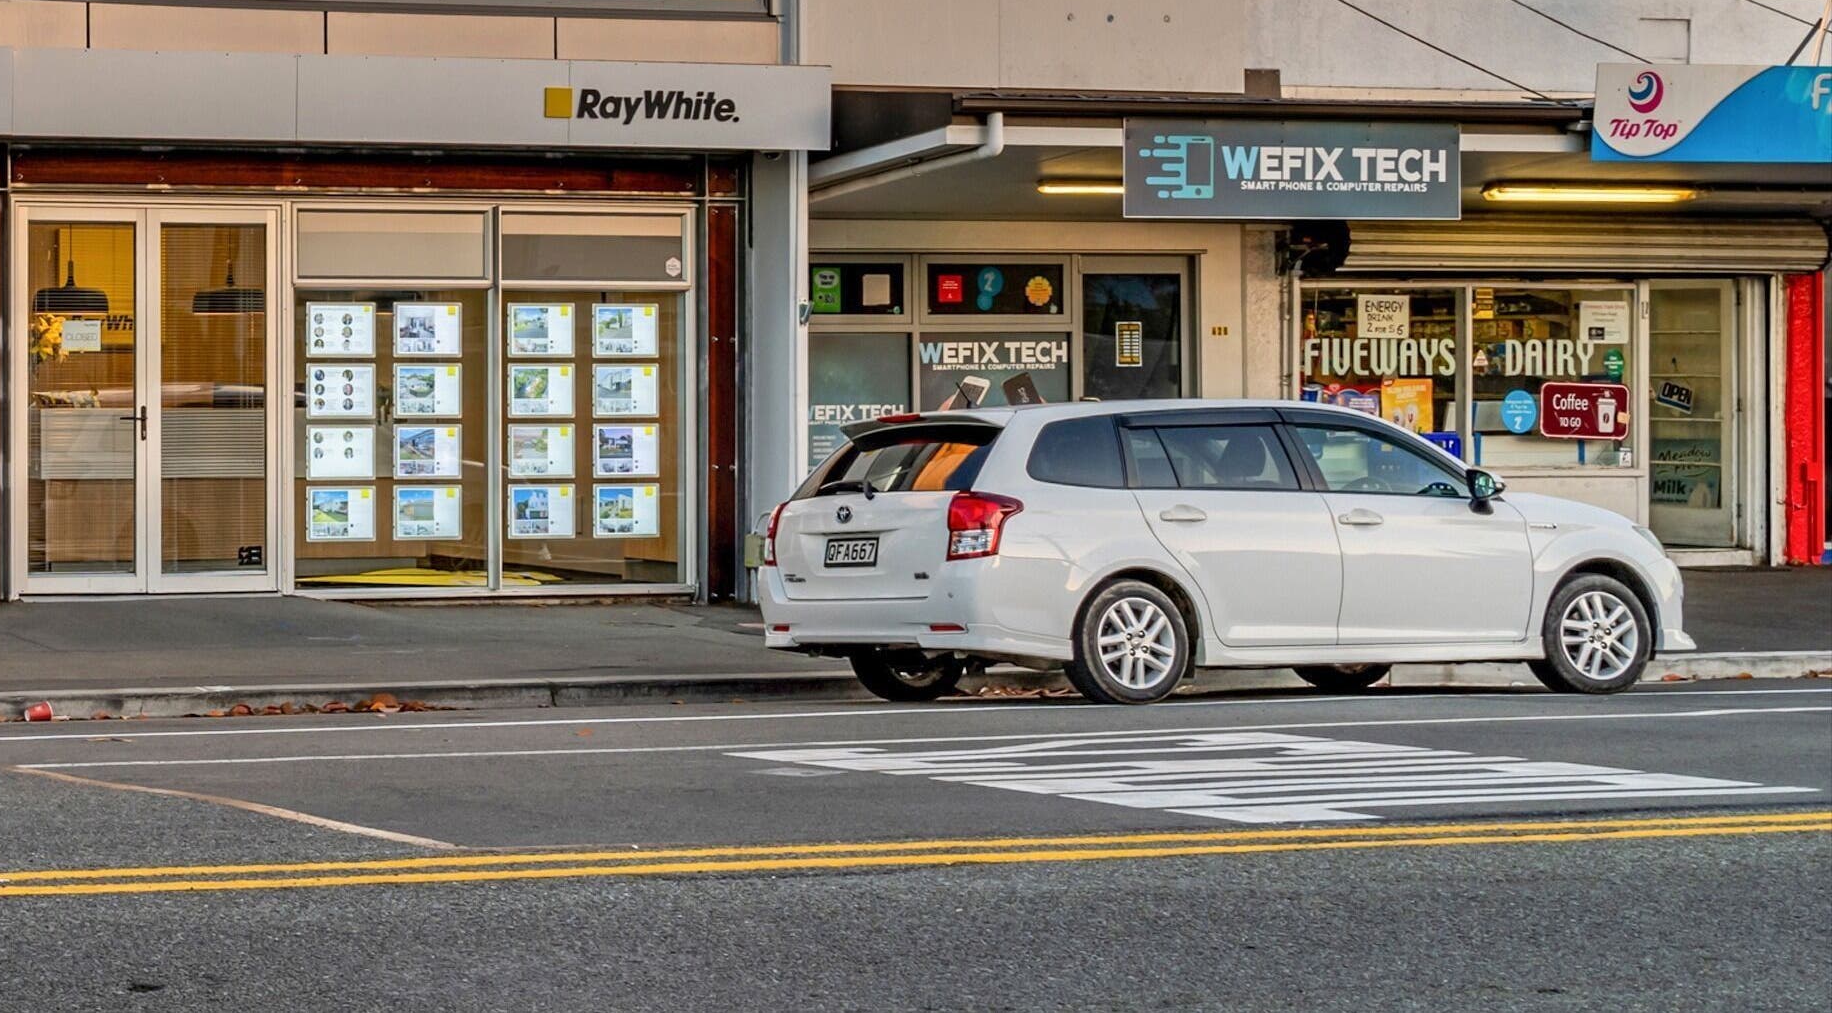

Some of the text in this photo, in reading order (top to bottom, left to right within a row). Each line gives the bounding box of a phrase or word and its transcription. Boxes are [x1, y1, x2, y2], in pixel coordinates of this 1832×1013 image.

[1609, 118, 1679, 140] Tip Top
[1222, 146, 1447, 183] WEFIX TECH
[1240, 180, 1428, 193] SMART PHONE & COMPUTER REPAIRS
[1365, 299, 1404, 313] ENERGY
[1367, 313, 1394, 322] DRINK
[1367, 322, 1373, 333] 2
[66, 332, 98, 341] CLOSED
[919, 341, 1068, 364] WEFIX TECH
[1304, 338, 1456, 376] FIVEWAYS
[1505, 339, 1595, 376] DAIRY
[1662, 381, 1693, 405] OPEN
[1552, 393, 1589, 411] Coffee
[1559, 417, 1582, 428] TO GO
[1653, 479, 1687, 495] Milk
[827, 542, 876, 562] QFA667
